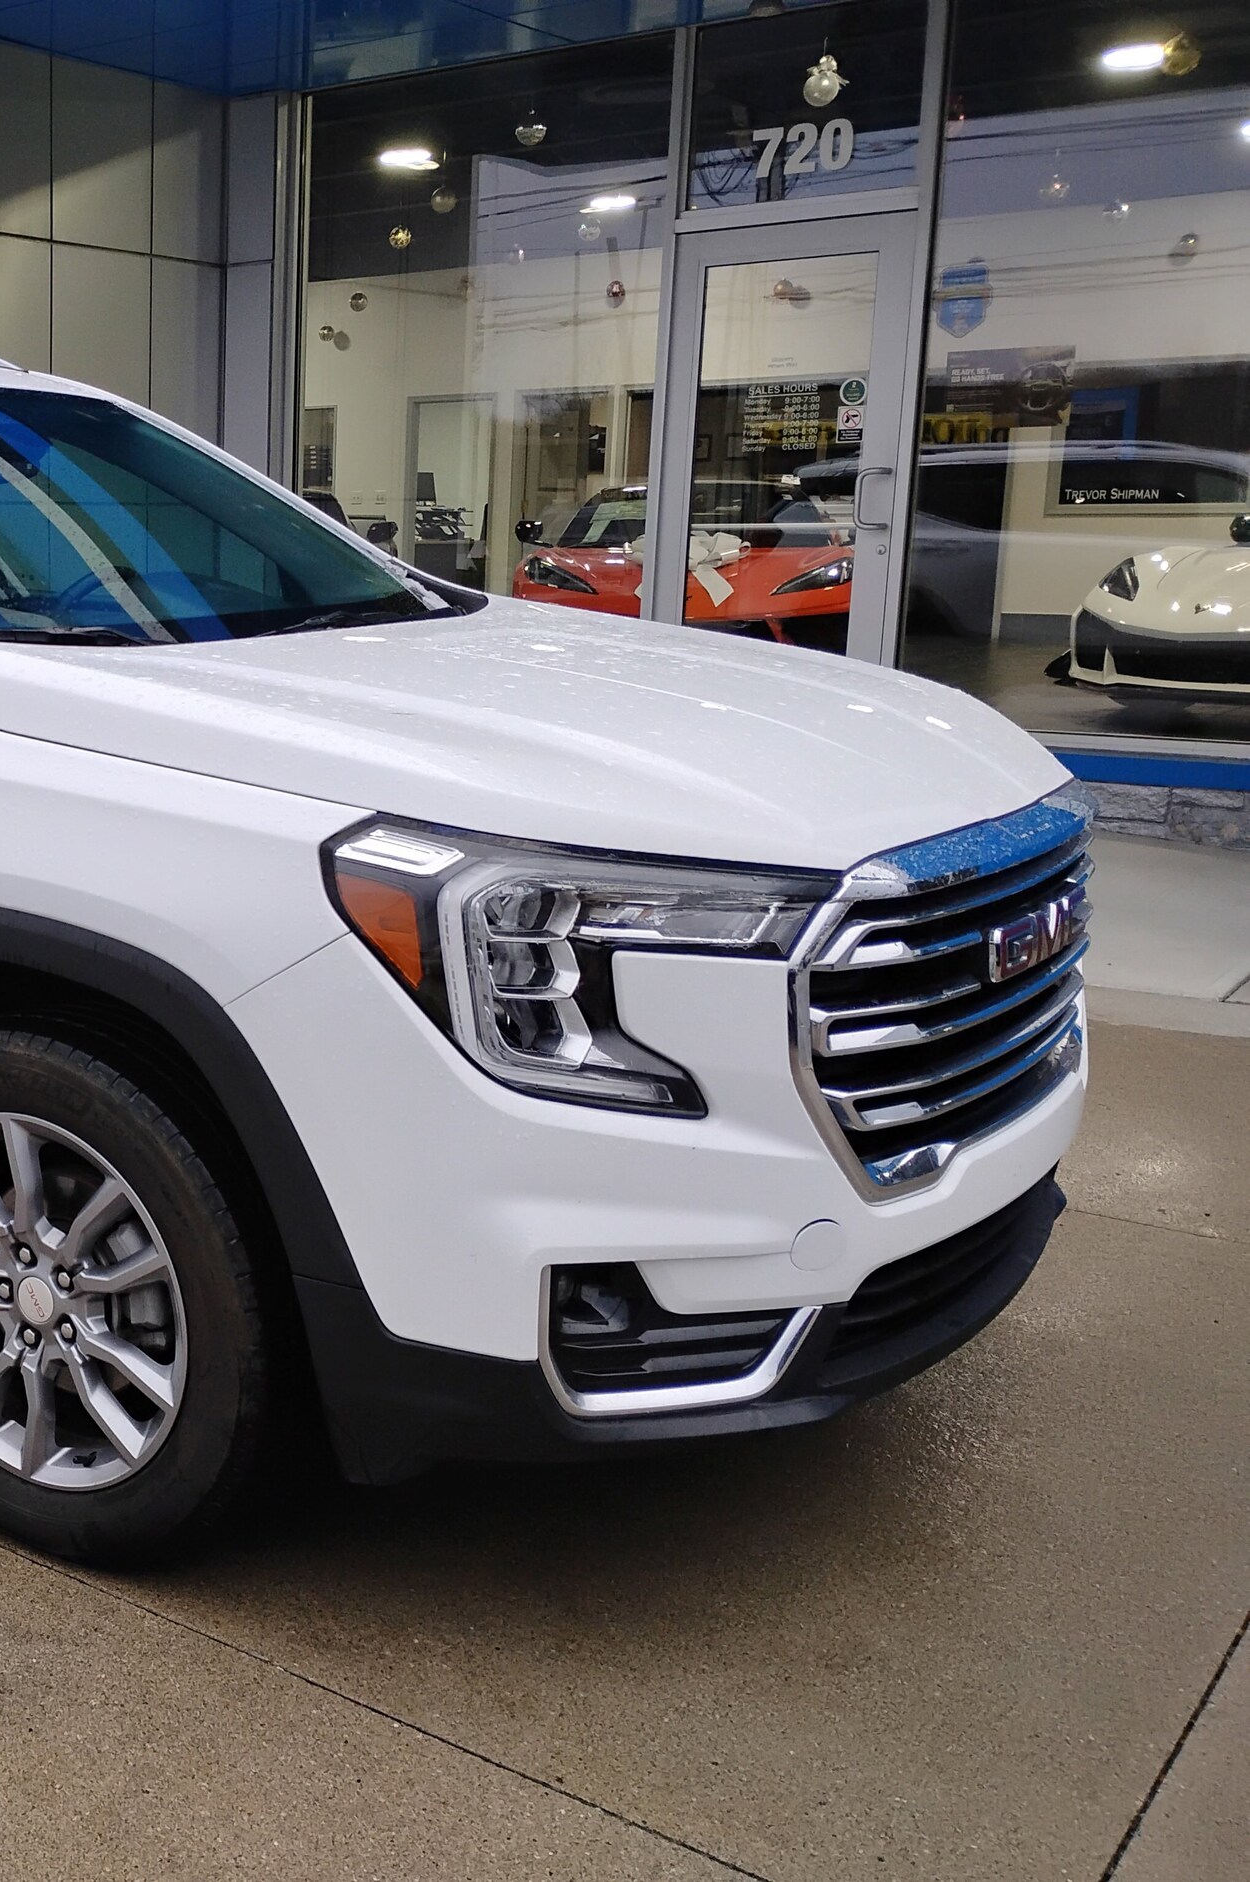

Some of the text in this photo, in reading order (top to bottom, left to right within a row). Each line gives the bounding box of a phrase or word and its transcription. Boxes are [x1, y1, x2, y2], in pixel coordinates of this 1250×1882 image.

[753, 118, 854, 178] 720
[749, 383, 818, 396] SALES HOURS
[785, 396, 821, 404] 9:00-7:00
[745, 406, 771, 414] Tuesday
[744, 412, 782, 421] Wednesday
[744, 421, 773, 430] Thursday
[743, 430, 763, 438] Friday
[743, 437, 771, 445] Saturday
[742, 442, 816, 453] Sunday CLOSED
[1064, 487, 1159, 500] TREVOR SHIPMAN
[990, 888, 1087, 982] GMC
[26, 1282, 45, 1318] GMC
